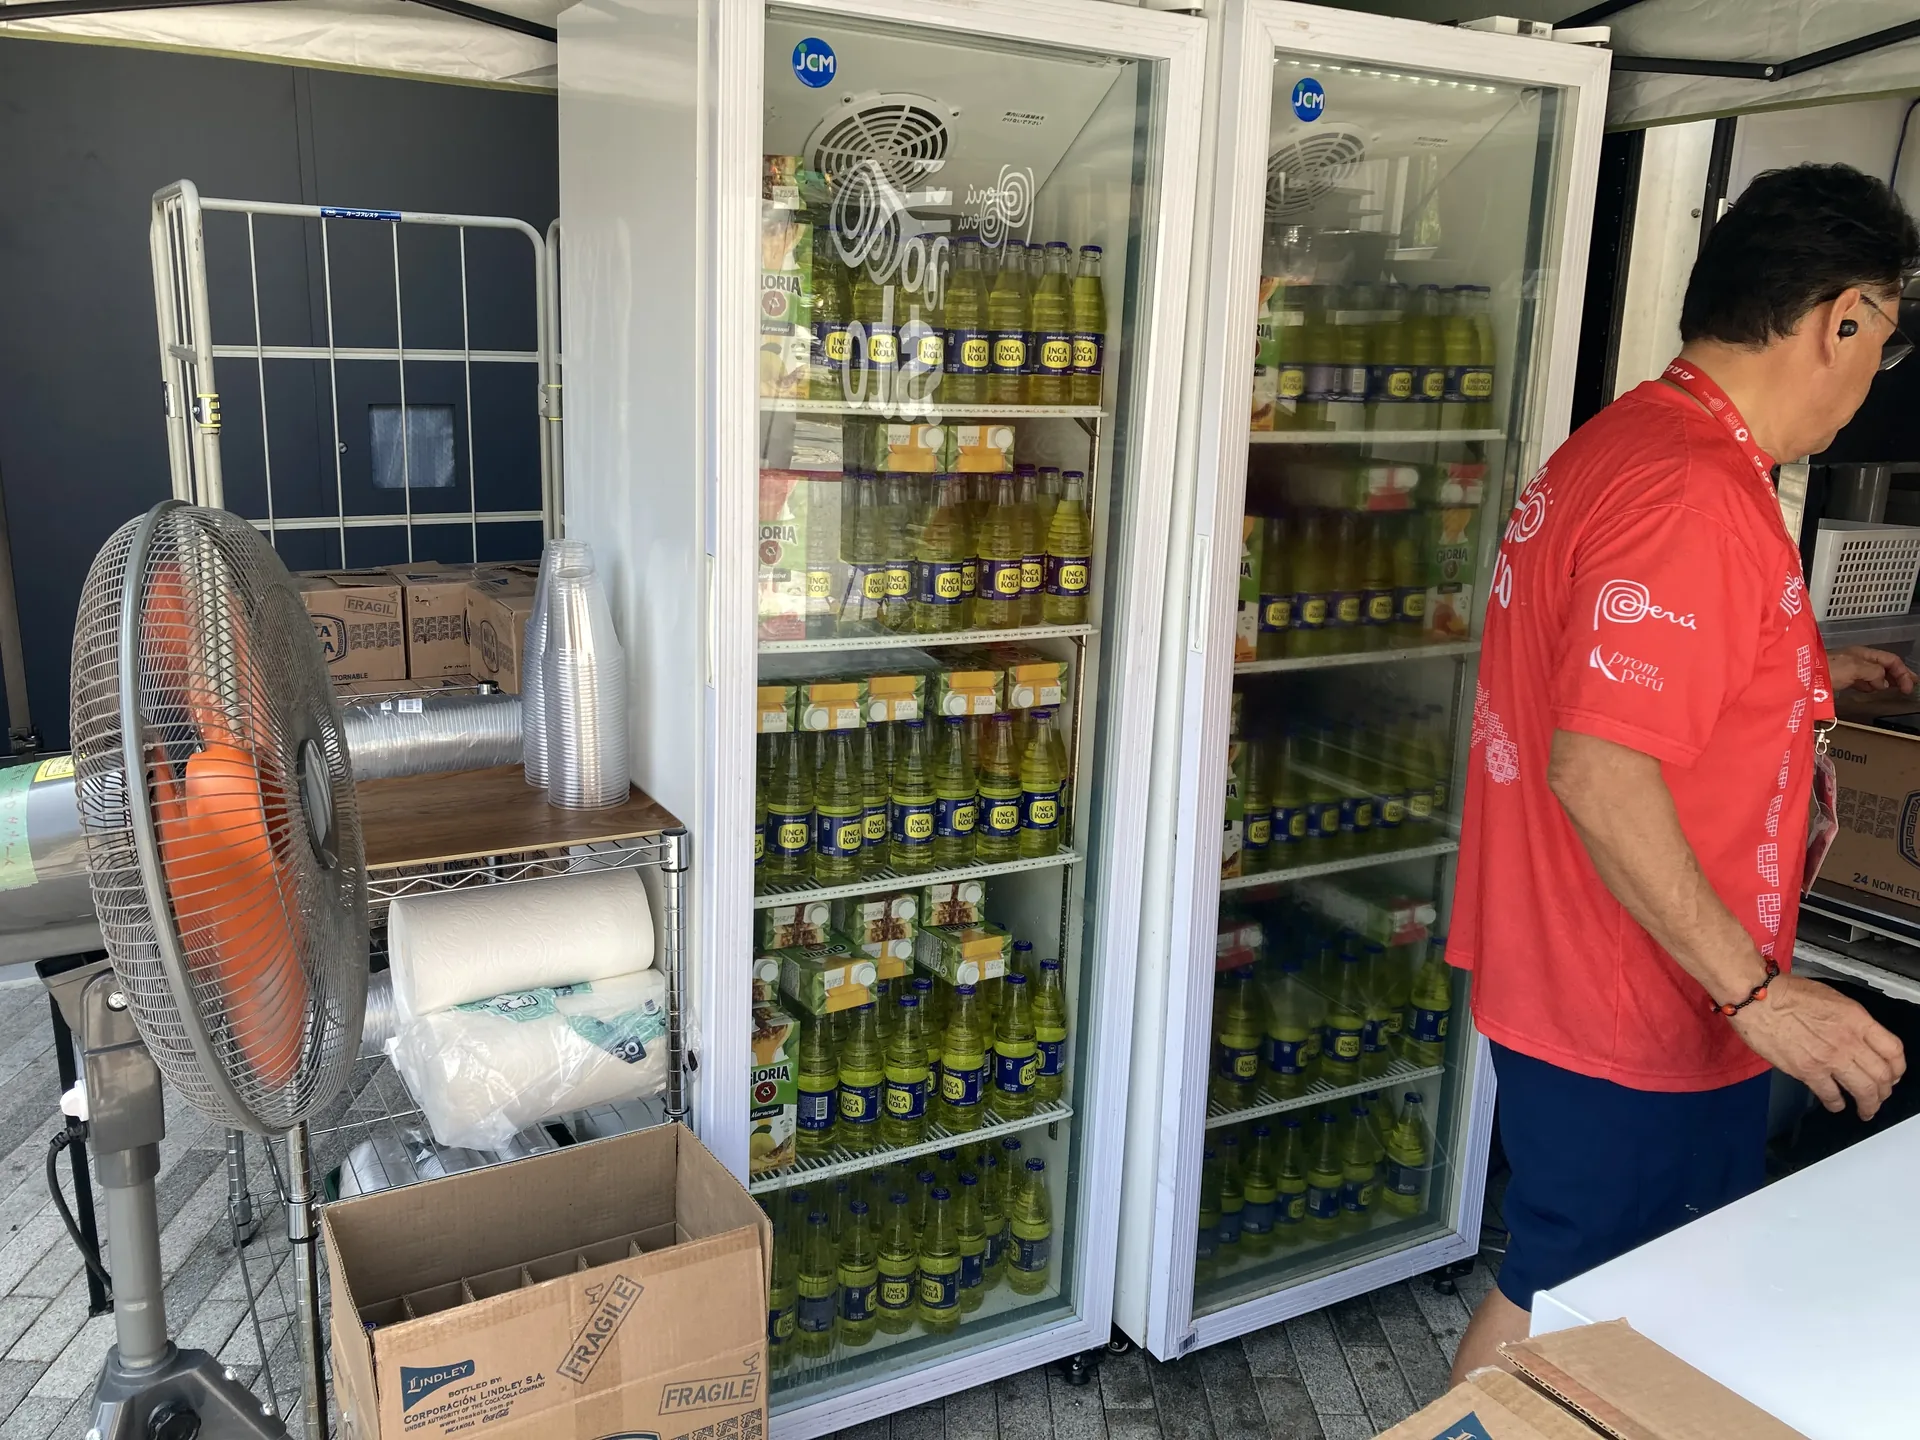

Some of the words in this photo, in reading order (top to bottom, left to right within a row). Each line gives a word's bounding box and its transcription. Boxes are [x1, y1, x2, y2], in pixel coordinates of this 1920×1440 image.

[796, 53, 835, 73] JCM
[1295, 90, 1324, 110] JCM
[761, 274, 802, 297] LORIA
[1000, 345, 1020, 354] INCA
[1048, 346, 1067, 354] INCA
[998, 354, 1021, 362] KOLA
[1046, 354, 1068, 363] KOLA
[759, 525, 798, 545] LORIA
[1022, 568, 1039, 576] INCA
[1066, 570, 1084, 578] INCA
[809, 576, 829, 585] INCA
[888, 574, 906, 582] INCA
[942, 577, 960, 585] INCA
[1002, 574, 1019, 582] INCA
[1021, 575, 1040, 583] KOLA
[1064, 576, 1084, 584] KOLA
[808, 584, 830, 593] KOLA
[886, 582, 908, 591] KOLA
[940, 584, 960, 593] KOLA
[1000, 581, 1020, 589] KOLA
[348, 599, 394, 615] FRAGIL
[1594, 579, 1697, 631] Perú
[1606, 651, 1660, 677] prom
[331, 672, 368, 681] ETORNABLE
[1619, 668, 1665, 692] perú
[1829, 747, 1868, 765] 300ml
[1034, 812, 1054, 820] KOLA
[869, 818, 884, 826] INCA
[912, 818, 930, 826] INCA
[785, 828, 804, 836] INCA
[868, 826, 885, 834] KOLA
[910, 826, 930, 834] KOLA
[783, 836, 804, 844] KOLA
[1852, 872, 1868, 886] 24
[1872, 878, 1894, 893] NON
[890, 1093, 907, 1102] INCA
[889, 1100, 908, 1110] KOLA
[566, 1280, 637, 1376] FRAGILE
[408, 1365, 468, 1394] LINDLEY
[448, 1381, 488, 1398] BOTTLED
[664, 1378, 756, 1408] FRAGILE
[404, 1396, 476, 1424] CORPORACIÓN
[480, 1380, 523, 1399] LINDLEY
[526, 1372, 546, 1384] S.A.
[404, 1422, 426, 1432] UNDER
[428, 1410, 460, 1425] AUTHORITY
[462, 1406, 470, 1414] OF
[471, 1402, 484, 1410] THE
[519, 1382, 546, 1394] COMPANY
